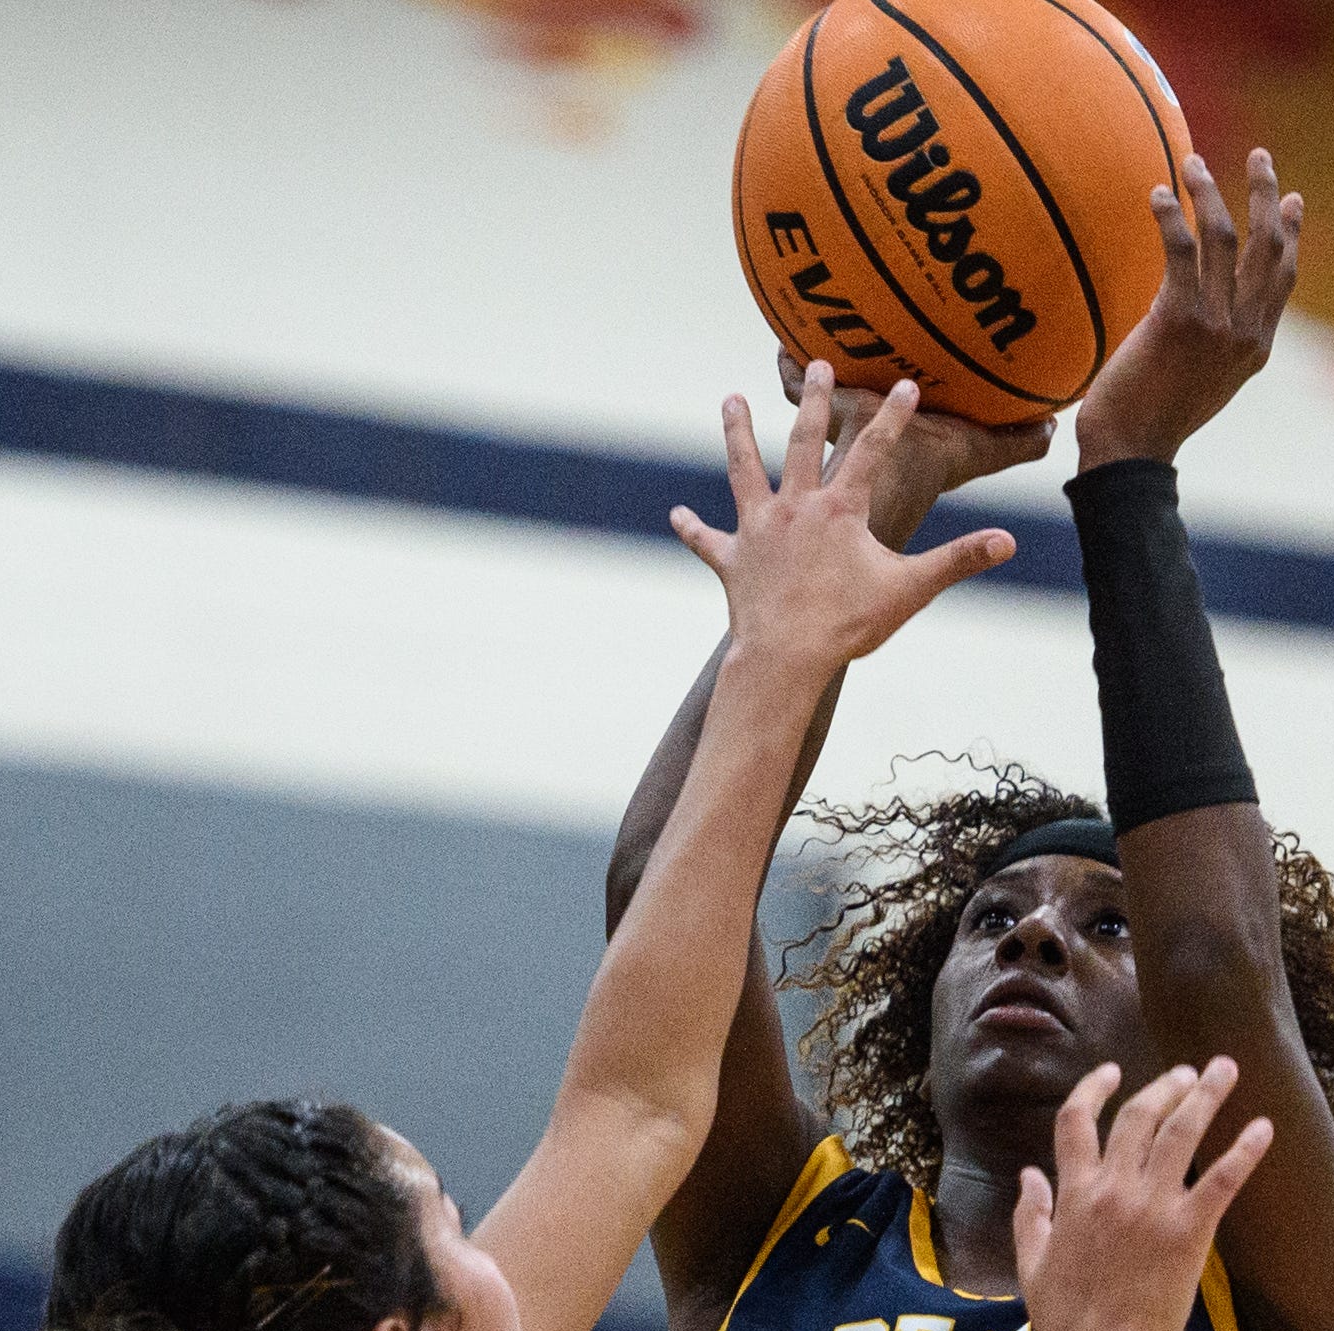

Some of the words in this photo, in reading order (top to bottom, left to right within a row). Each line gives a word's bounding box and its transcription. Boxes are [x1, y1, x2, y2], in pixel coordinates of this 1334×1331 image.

[845, 55, 1037, 352] Wilson
[860, 173, 897, 226] INDOOR
[896, 228, 925, 269] GAME
[765, 211, 895, 360] EVO
